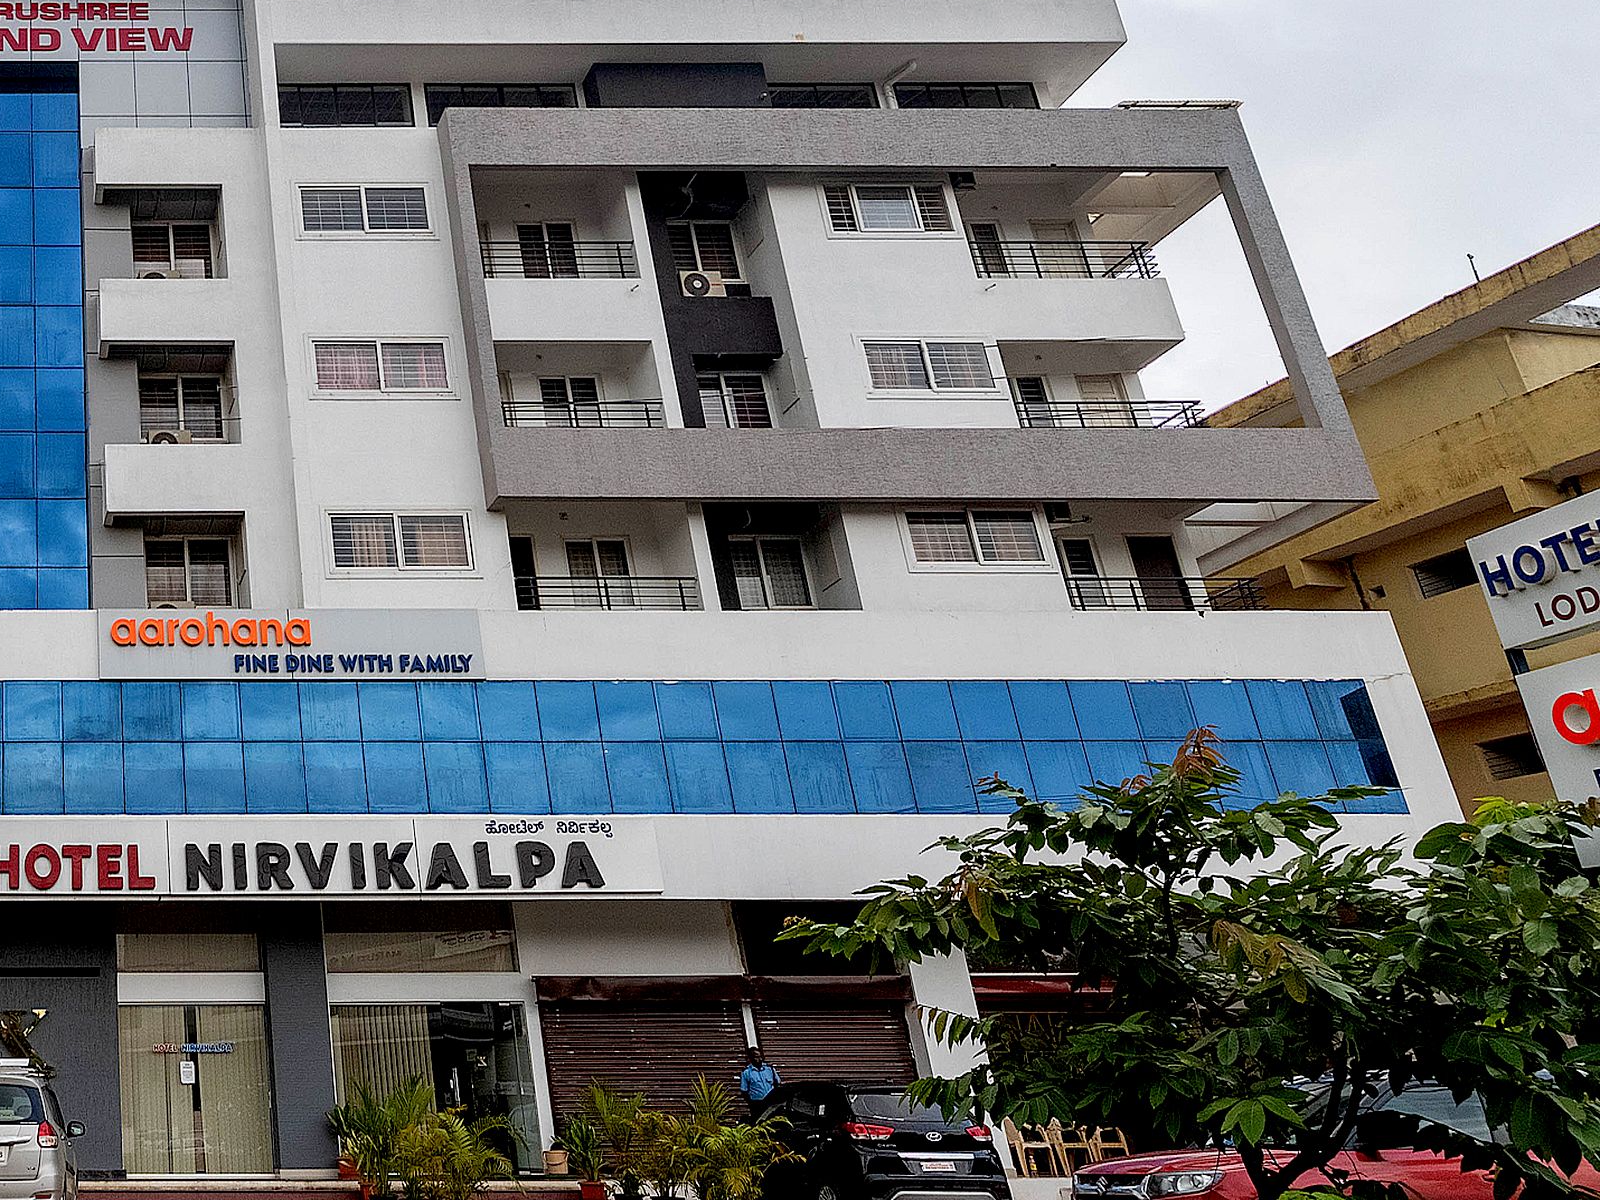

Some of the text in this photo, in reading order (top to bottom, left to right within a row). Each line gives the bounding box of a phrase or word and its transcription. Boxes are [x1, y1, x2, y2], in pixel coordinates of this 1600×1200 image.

[71, 27, 194, 52] VIEW
[1478, 518, 1600, 597] HOTE
[1534, 586, 1600, 628] LOD
[110, 611, 312, 647] aarohana
[234, 653, 474, 674] FINE DINE WITH FAMILY
[184, 841, 608, 892] NIRVIKALPA
[152, 1042, 178, 1053] HOTEL
